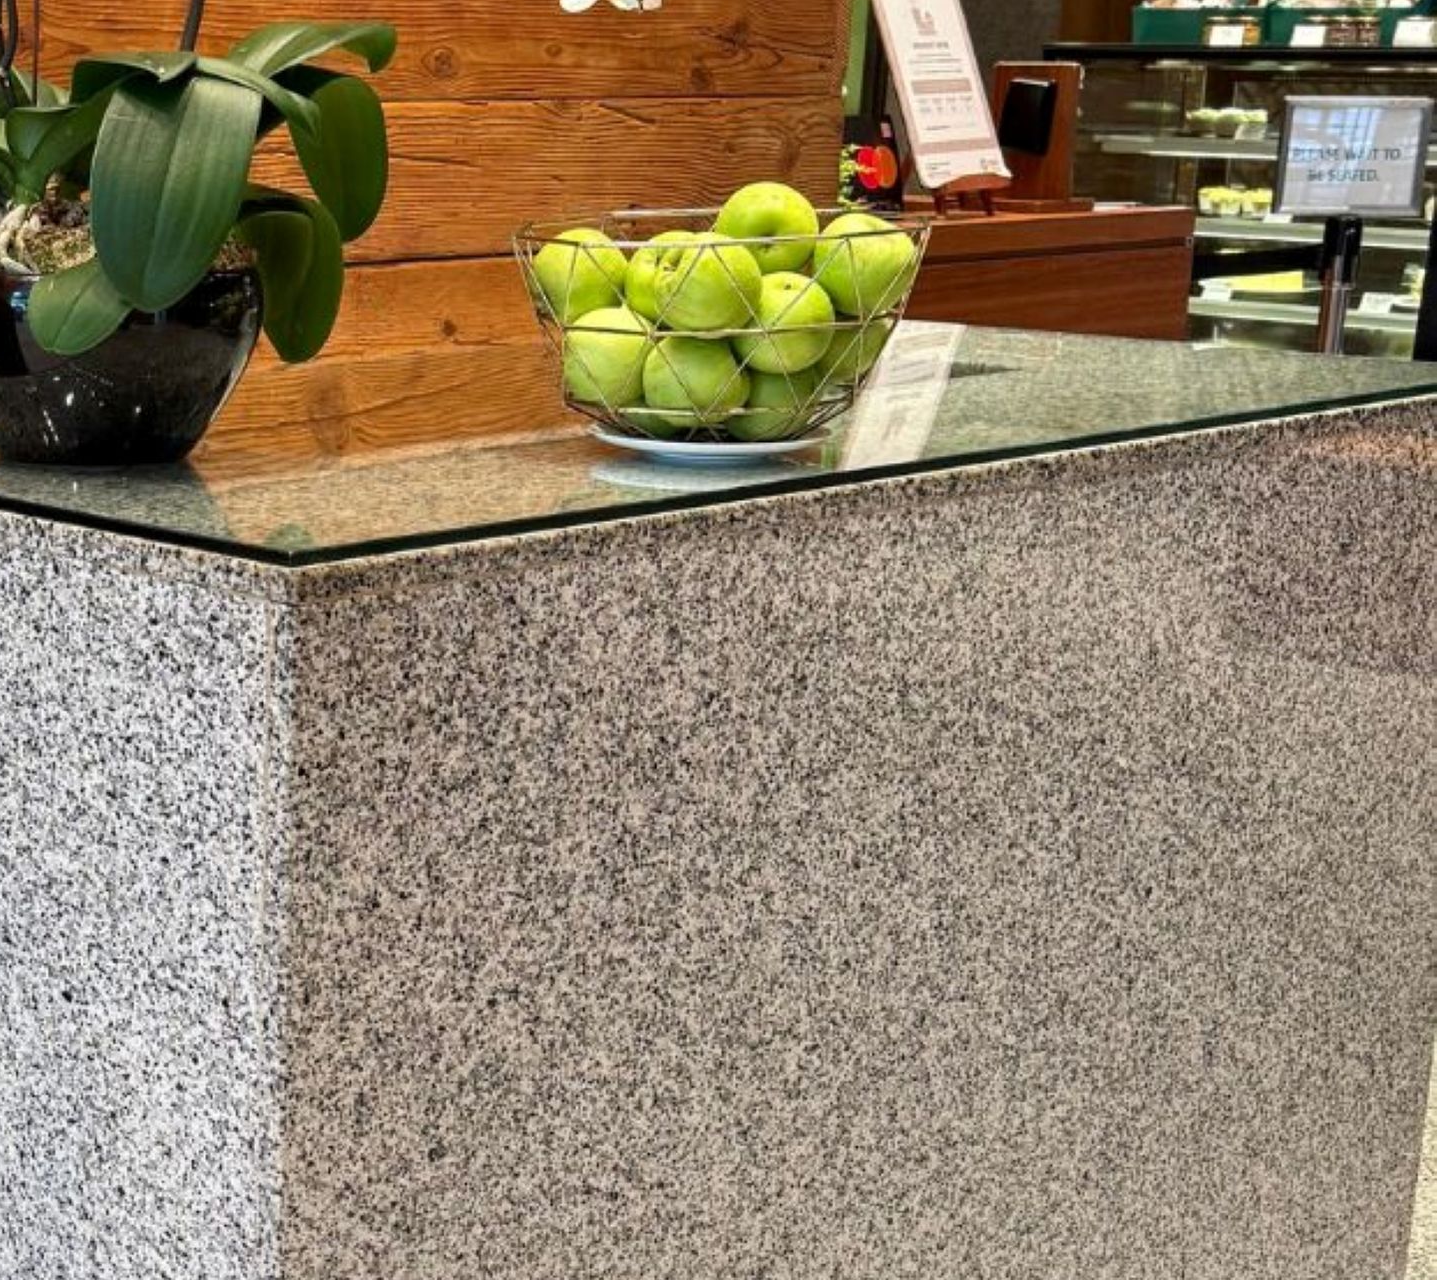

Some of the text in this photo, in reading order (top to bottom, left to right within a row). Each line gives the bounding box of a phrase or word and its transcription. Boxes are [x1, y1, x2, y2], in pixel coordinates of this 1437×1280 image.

[1345, 147, 1378, 161] WAIT
[1383, 147, 1402, 161] TO
[1307, 169, 1324, 182] BE
